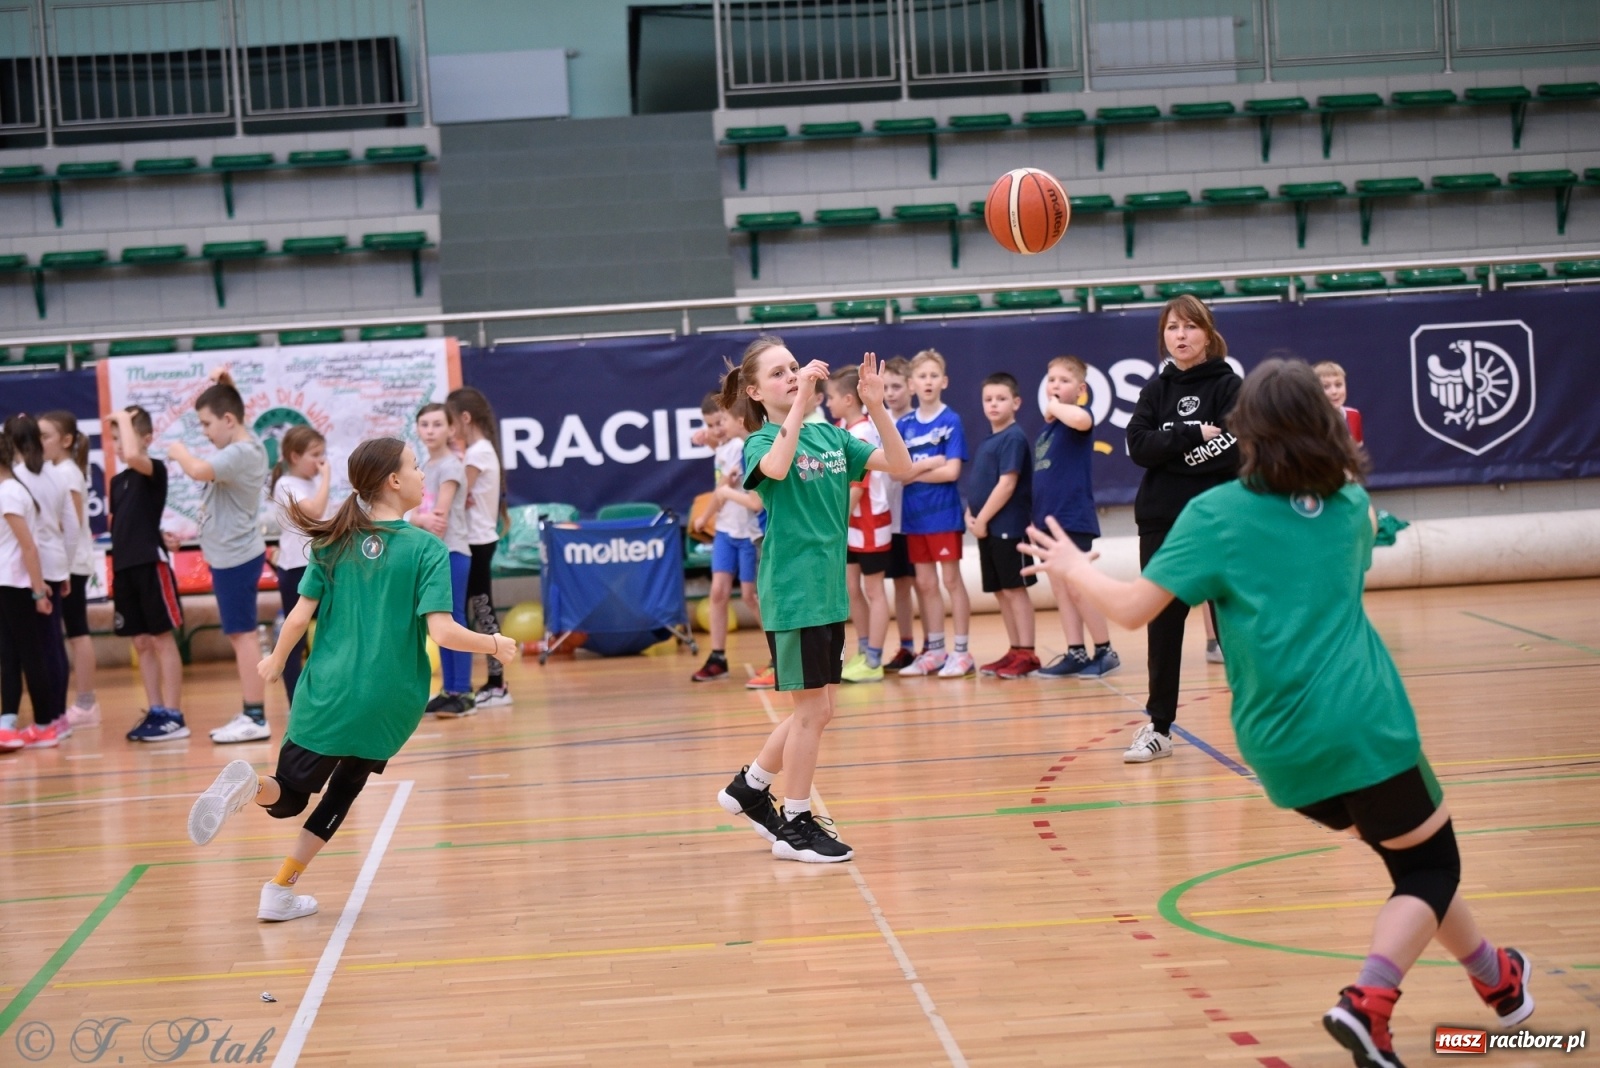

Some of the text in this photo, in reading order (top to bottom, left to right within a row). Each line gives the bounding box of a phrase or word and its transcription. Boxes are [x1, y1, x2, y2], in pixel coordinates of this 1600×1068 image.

[1047, 189, 1063, 238] molten
[500, 408, 716, 470] RACIB
[1184, 432, 1238, 467] TRENER
[564, 537, 665, 565] molten
